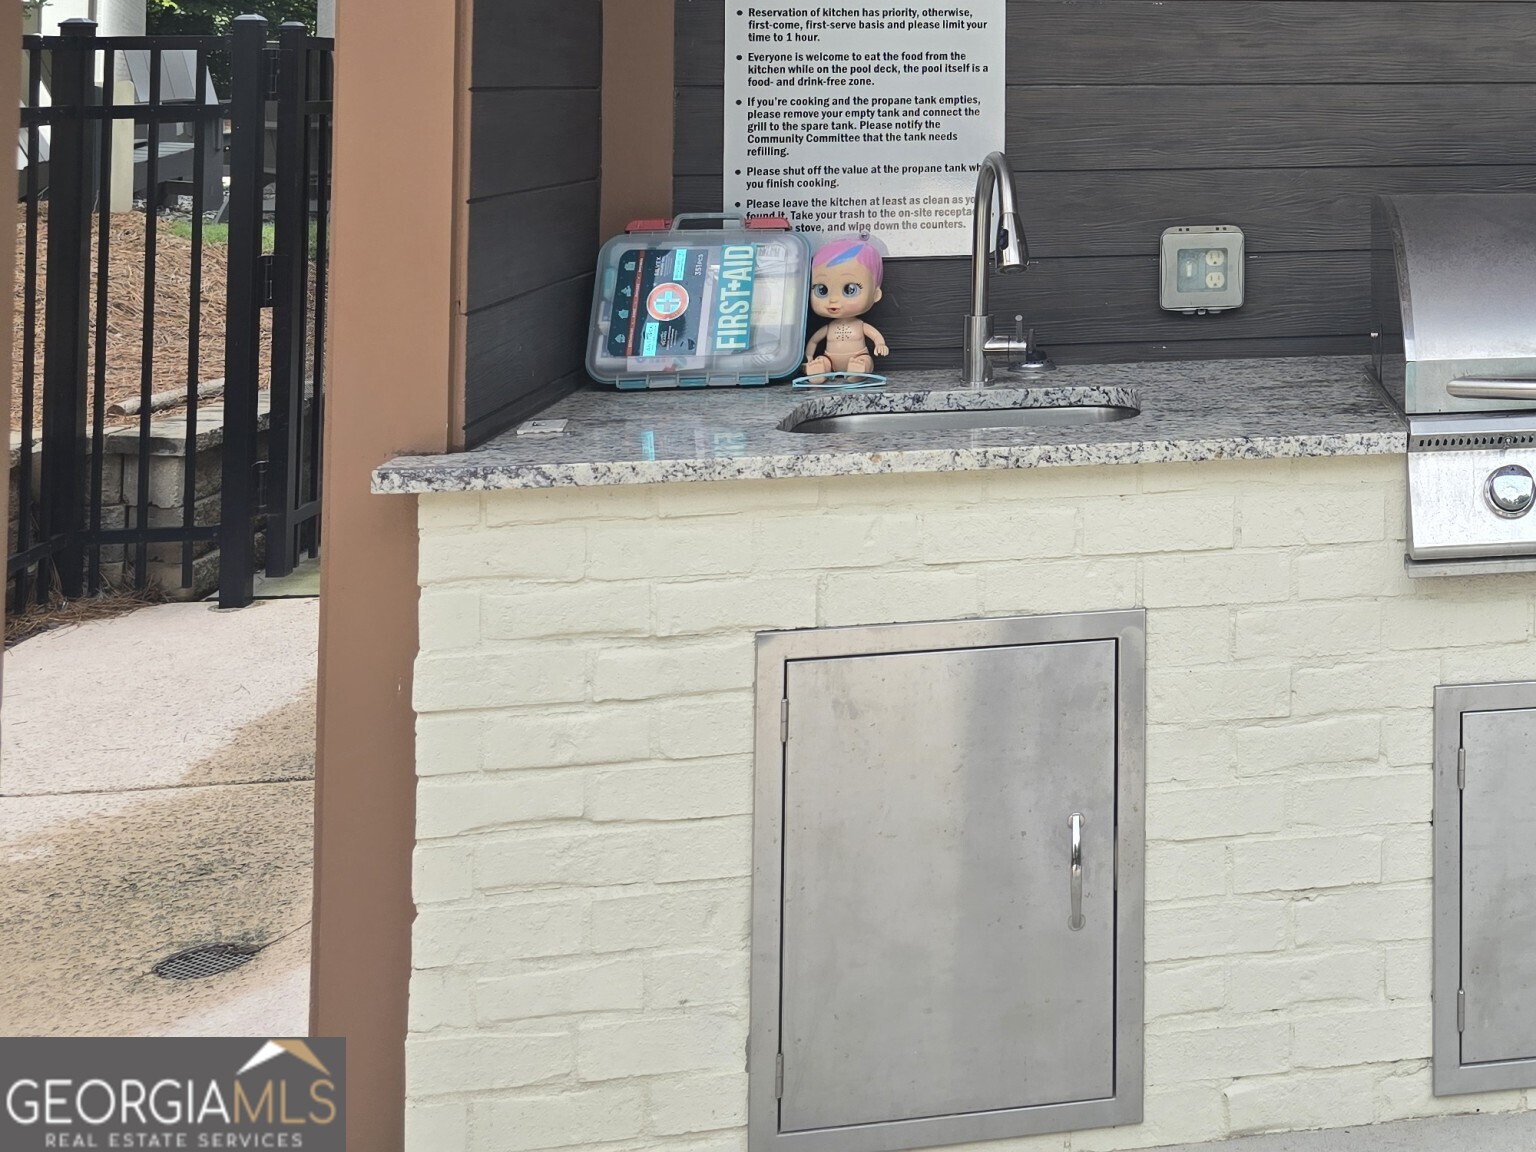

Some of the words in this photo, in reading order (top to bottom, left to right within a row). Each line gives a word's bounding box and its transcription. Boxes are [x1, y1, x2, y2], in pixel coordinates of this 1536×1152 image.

[749, 8, 807, 17] Reservation
[810, 8, 820, 16] of
[823, 8, 859, 16] kitchen
[862, 8, 880, 16] has
[882, 8, 919, 18] priority,
[922, 8, 972, 18] otherwise,
[748, 20, 803, 31] first-come,
[806, 20, 856, 29] first-serve
[859, 20, 884, 28] basis
[888, 20, 905, 28] and
[908, 20, 940, 31] please
[943, 20, 964, 28] limit
[966, 22, 987, 30] your
[748, 33, 770, 42] time
[774, 33, 783, 42] to
[787, 33, 792, 41] 1
[796, 33, 820, 41] hour.
[748, 53, 792, 63] Everyone
[796, 52, 803, 61] is
[806, 52, 849, 61] welcome
[852, 52, 862, 61] to
[865, 52, 880, 61] eat
[883, 52, 898, 60] the
[902, 52, 922, 60] food
[926, 52, 948, 60] from
[950, 52, 966, 60] the
[748, 65, 785, 74] kitchen
[788, 65, 814, 73] while
[832, 64, 847, 73] the
[850, 64, 871, 75] pool
[874, 64, 900, 74] deck,
[904, 64, 919, 72] the
[922, 64, 942, 74] pool
[945, 64, 970, 72] itself
[972, 64, 980, 72] is
[748, 77, 773, 86] food-
[776, 77, 794, 86] and
[798, 77, 846, 86] drink-free
[748, 97, 755, 106] If
[757, 97, 787, 108] you're
[790, 97, 830, 107] cooking
[832, 96, 850, 105] and
[853, 96, 868, 105] the
[872, 98, 912, 107] propane
[914, 96, 936, 104] tank
[939, 95, 980, 106] empties,
[748, 110, 780, 120] please
[822, 111, 843, 120] your
[845, 109, 875, 119] empty
[877, 108, 899, 117] tank
[902, 108, 920, 116] and
[923, 108, 962, 116] connect
[964, 107, 980, 116] the
[748, 122, 766, 132] grill
[770, 122, 779, 131] to
[782, 122, 798, 130] the
[801, 123, 828, 132] spare
[831, 121, 856, 130] tank.
[860, 121, 892, 129] Please
[895, 120, 922, 131] notify
[925, 120, 940, 128] the
[748, 134, 804, 144] Community
[806, 134, 860, 142] Committee
[863, 133, 883, 142] that
[886, 133, 901, 141] the
[904, 132, 926, 141] tank
[929, 132, 957, 140] needs
[748, 146, 789, 157] refilling.
[747, 167, 780, 176] Please
[783, 166, 805, 175] shut
[808, 166, 821, 175] off
[824, 166, 840, 174] the
[842, 165, 868, 174] value
[871, 165, 881, 173] at
[884, 165, 899, 173] the
[902, 166, 942, 175] propane
[945, 164, 966, 172] tank
[746, 181, 763, 190] you
[766, 179, 794, 188] finish
[797, 178, 839, 188] cooking.
[747, 199, 780, 208] Please
[783, 199, 808, 208] leave
[811, 198, 827, 207] the
[830, 197, 866, 206] kitchen
[870, 197, 880, 205] at
[882, 197, 906, 205] least
[923, 196, 949, 204] clean
[790, 210, 813, 220] Take
[816, 212, 837, 220] your
[839, 210, 864, 218] trash
[868, 210, 877, 218] to
[880, 209, 896, 218] the
[899, 208, 932, 217] on-site
[795, 223, 824, 233] stove,
[828, 222, 846, 231] and
[848, 222, 871, 232] wipe
[874, 221, 899, 230] down
[902, 220, 917, 229] the
[920, 220, 966, 229] counters.
